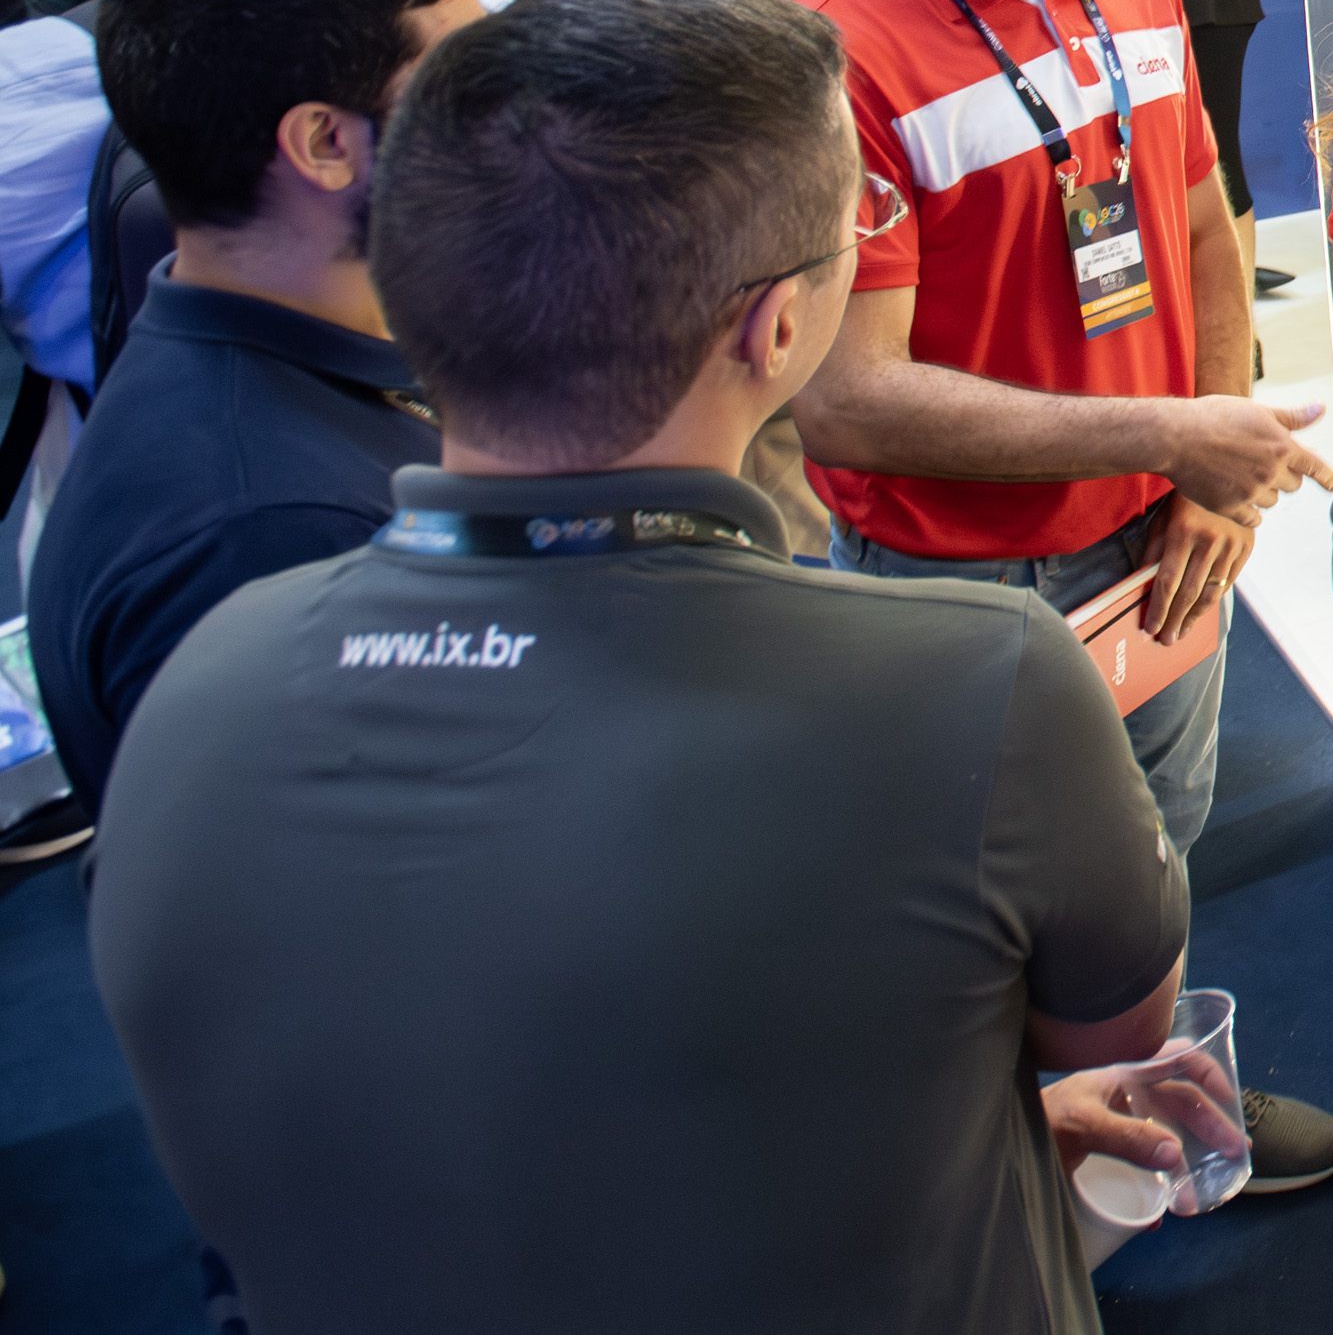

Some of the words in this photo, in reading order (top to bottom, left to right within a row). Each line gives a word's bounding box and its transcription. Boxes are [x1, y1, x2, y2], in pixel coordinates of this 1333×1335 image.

[1136, 57, 1170, 75] ciena
[338, 620, 537, 669] www.ix.br
[1111, 638, 1127, 686] ciena
